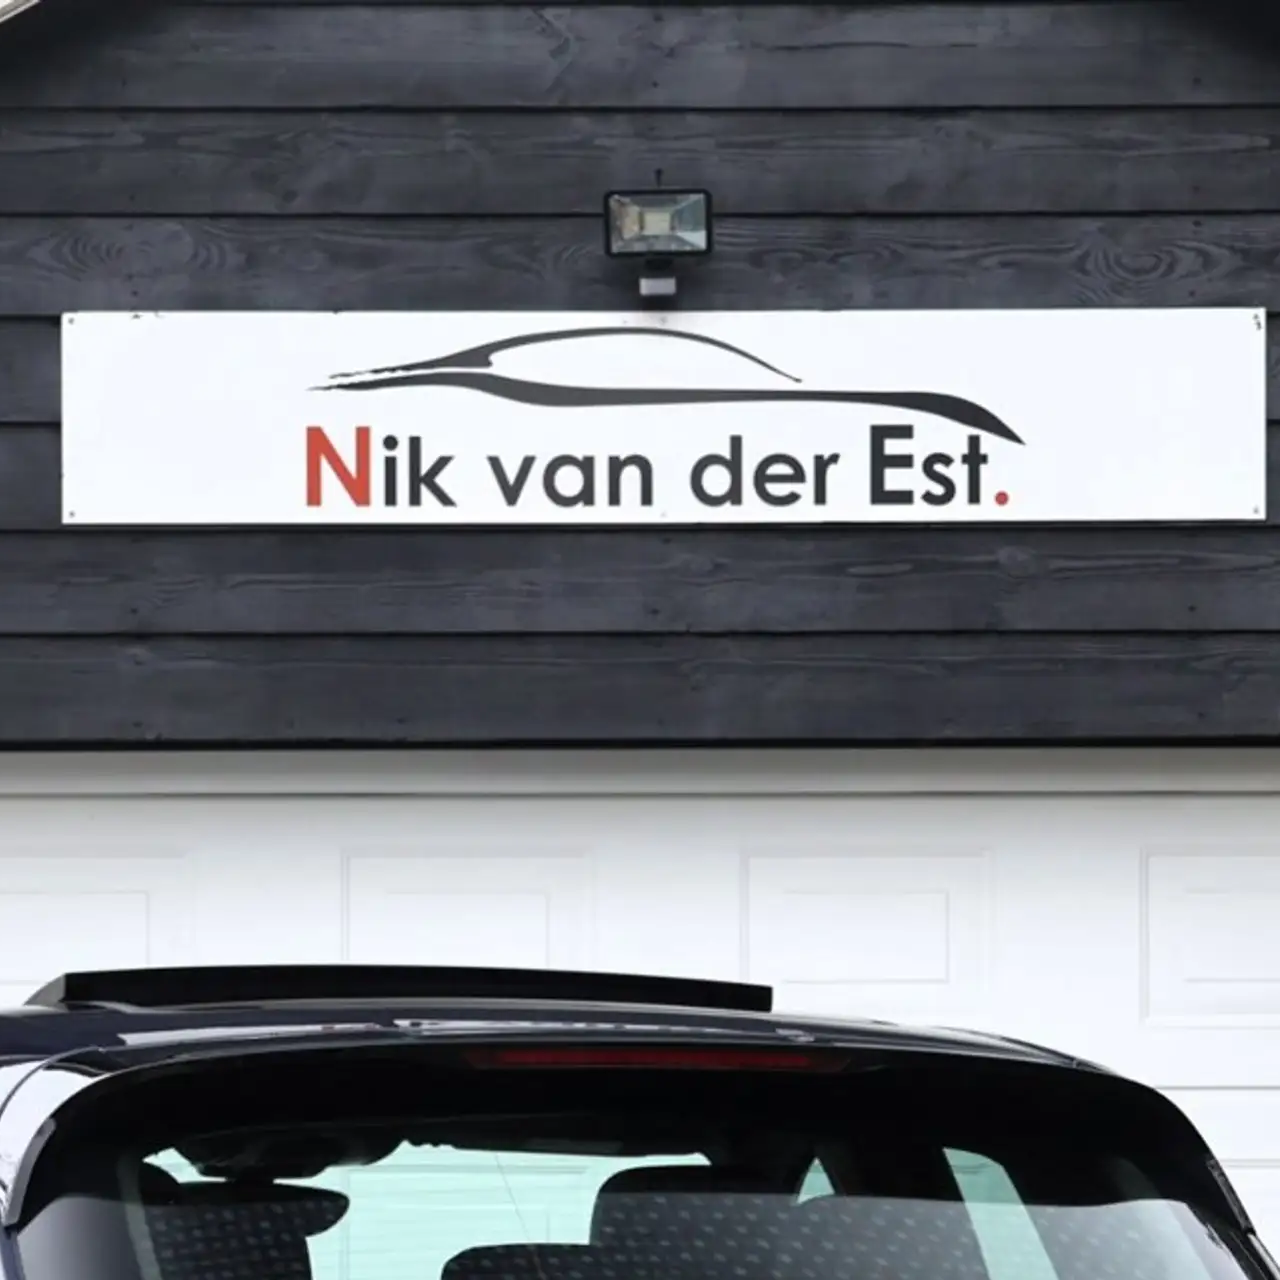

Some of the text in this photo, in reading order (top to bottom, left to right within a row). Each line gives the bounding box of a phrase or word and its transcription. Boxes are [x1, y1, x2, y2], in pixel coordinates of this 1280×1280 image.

[306, 424, 1009, 508] Nik van der Est.
